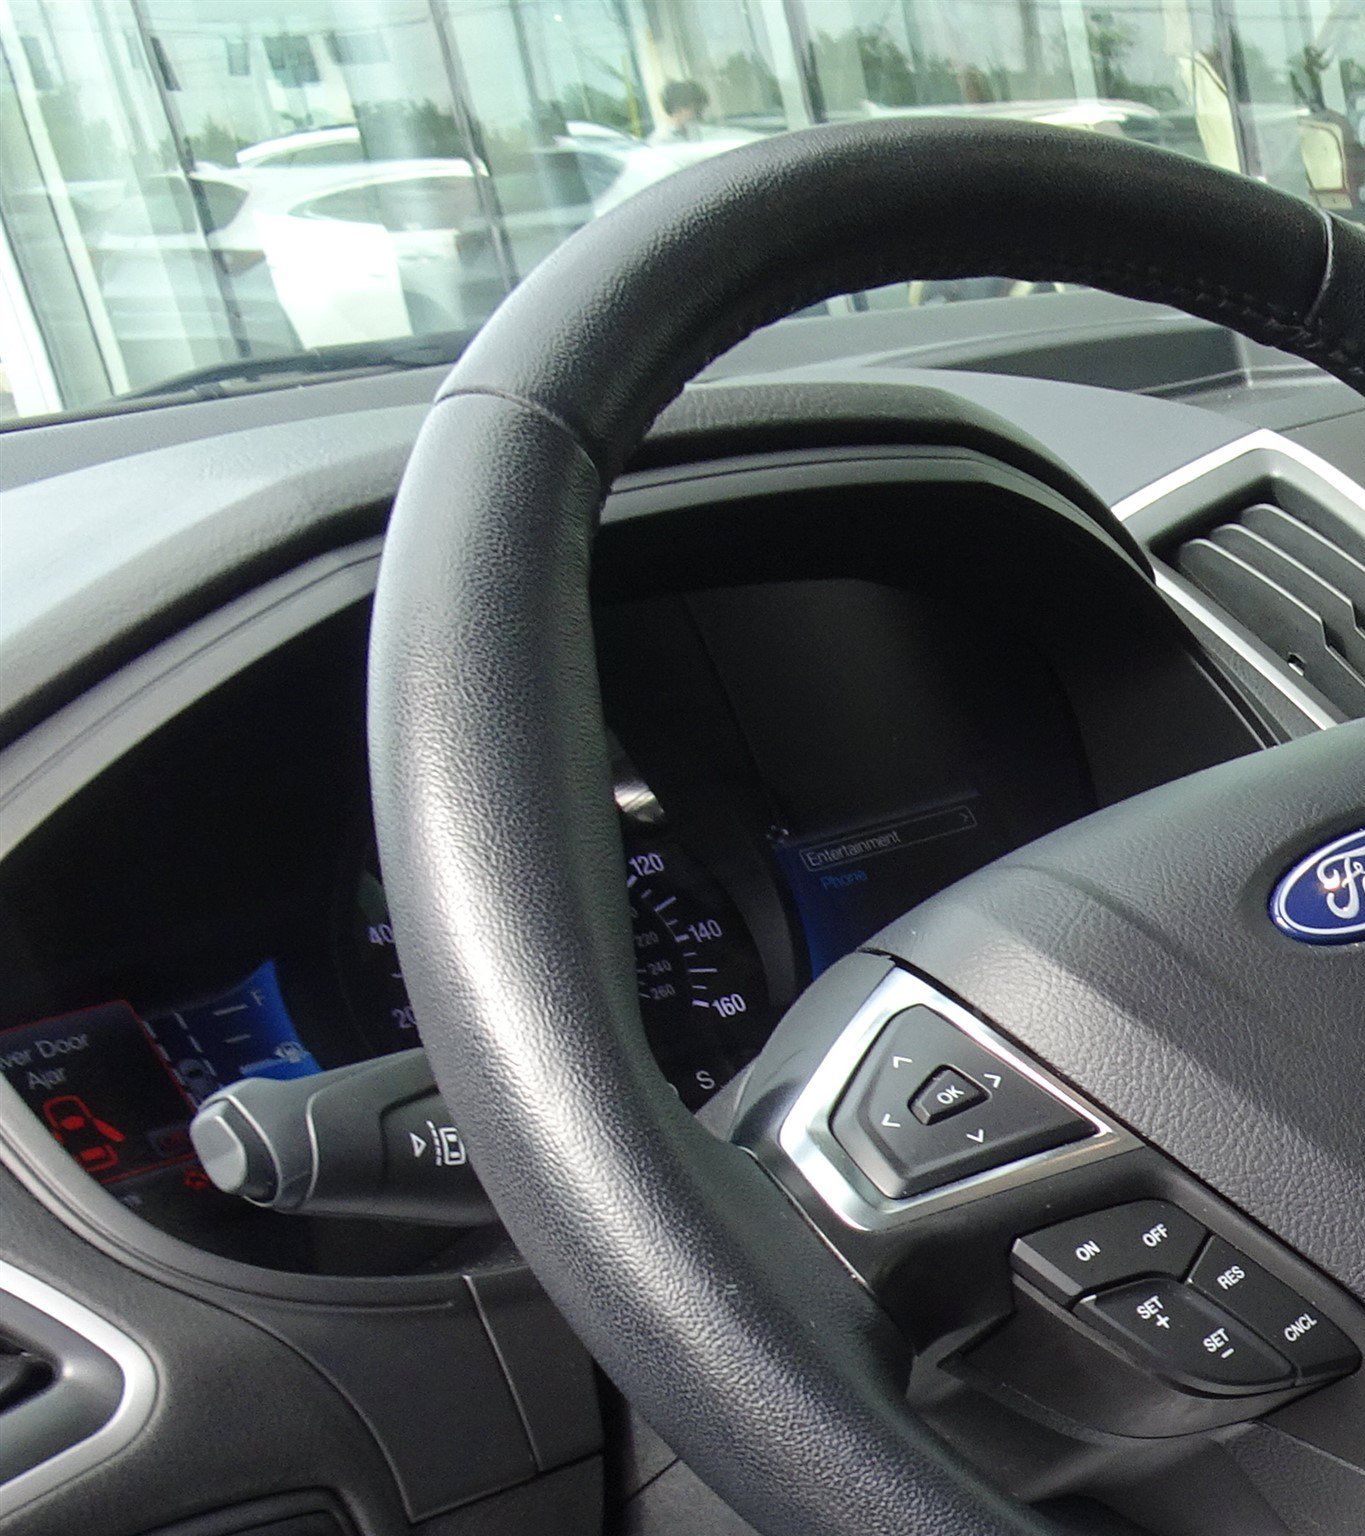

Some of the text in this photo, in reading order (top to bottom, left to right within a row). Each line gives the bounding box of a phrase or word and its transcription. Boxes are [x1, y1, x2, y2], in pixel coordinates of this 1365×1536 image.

[628, 852, 665, 877] 120
[688, 919, 723, 943] 140
[712, 993, 747, 1018] 160
[936, 1084, 964, 1106] OK
[1075, 1223, 1168, 1262] ON OFF
[1217, 1265, 1245, 1290] RES
[1137, 1295, 1164, 1320] SET
[1203, 1328, 1230, 1353] SET
[1284, 1313, 1317, 1343] CNCL
